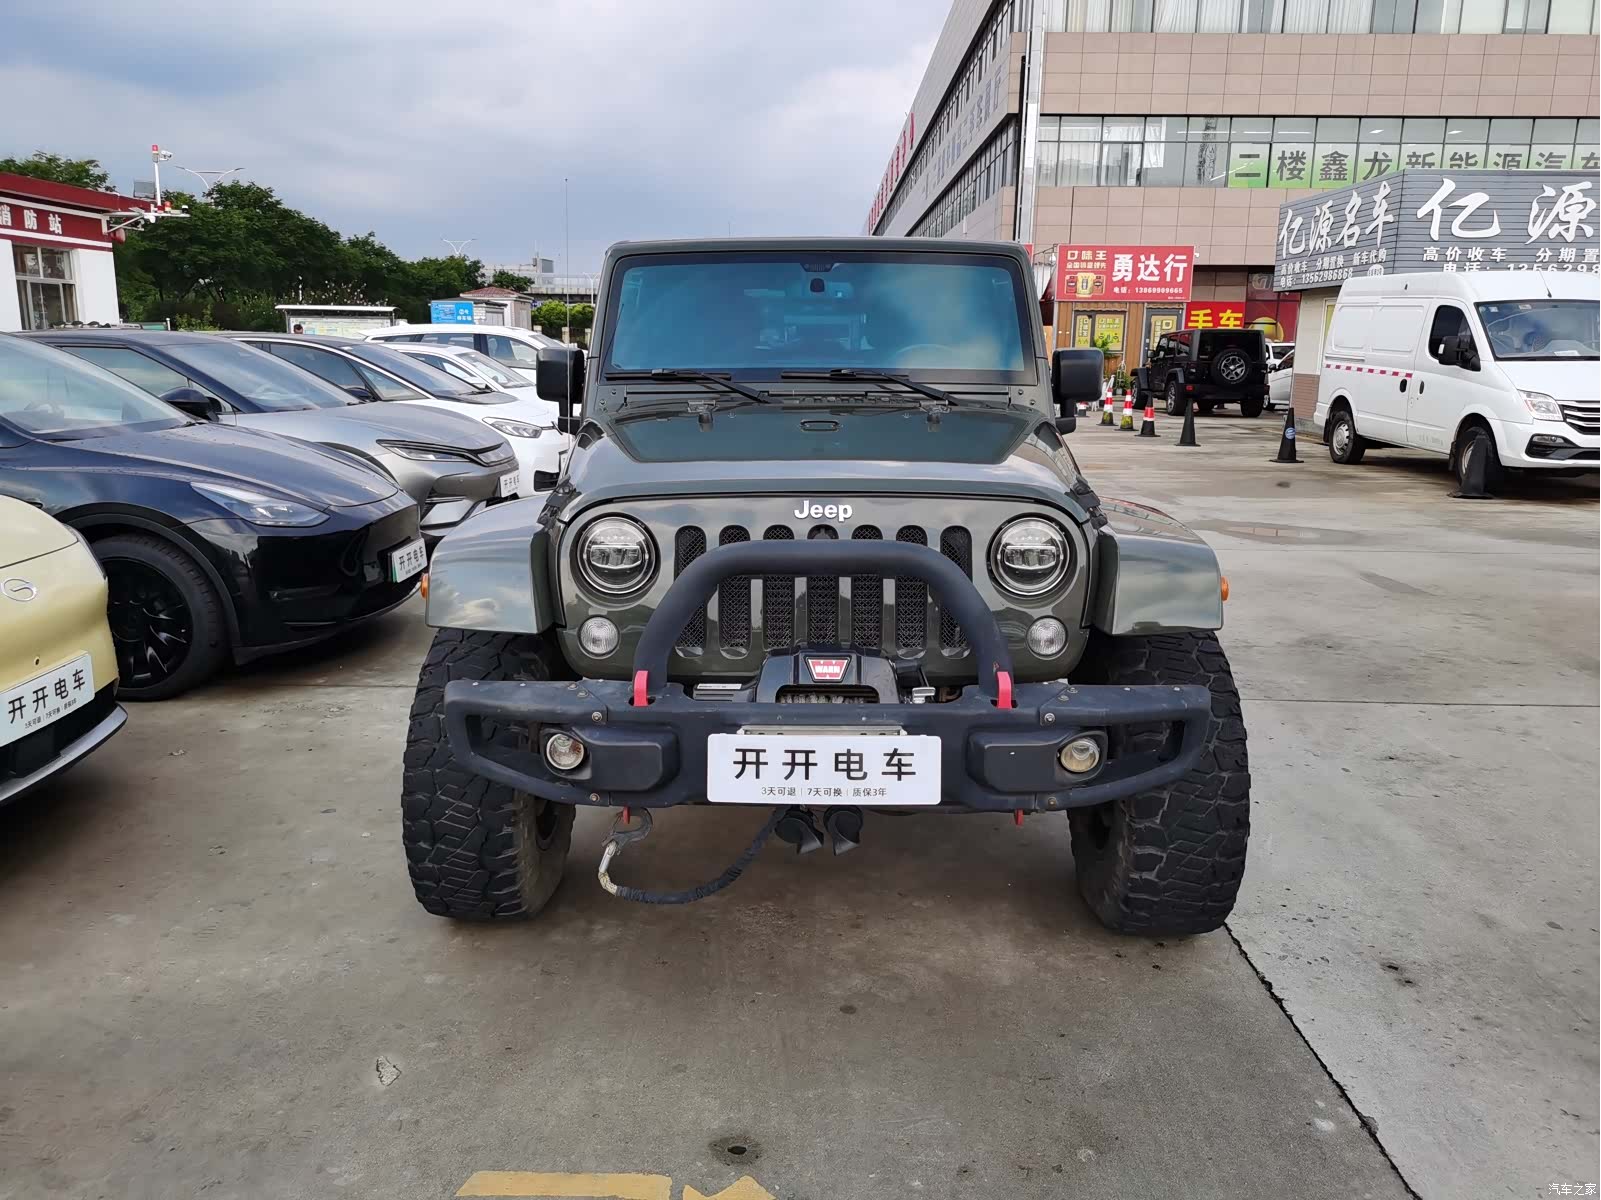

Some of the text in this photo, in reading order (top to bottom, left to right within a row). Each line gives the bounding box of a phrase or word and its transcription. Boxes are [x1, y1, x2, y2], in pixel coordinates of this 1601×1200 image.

[1279, 181, 1394, 259] 亿源名车
[1416, 177, 1597, 245] 亿源
[1067, 250, 1107, 261] 口味王
[1423, 246, 1507, 262] 高价收车
[1112, 253, 1188, 283] 勇达行
[1280, 261, 1308, 276] 高价收车
[794, 500, 853, 522] Jeep
[814, 665, 841, 674] WARN
[8, 668, 85, 724] 开开电车
[733, 748, 916, 781] 开开电车
[761, 786, 887, 798] 3天可退 7天可换 质保3年
